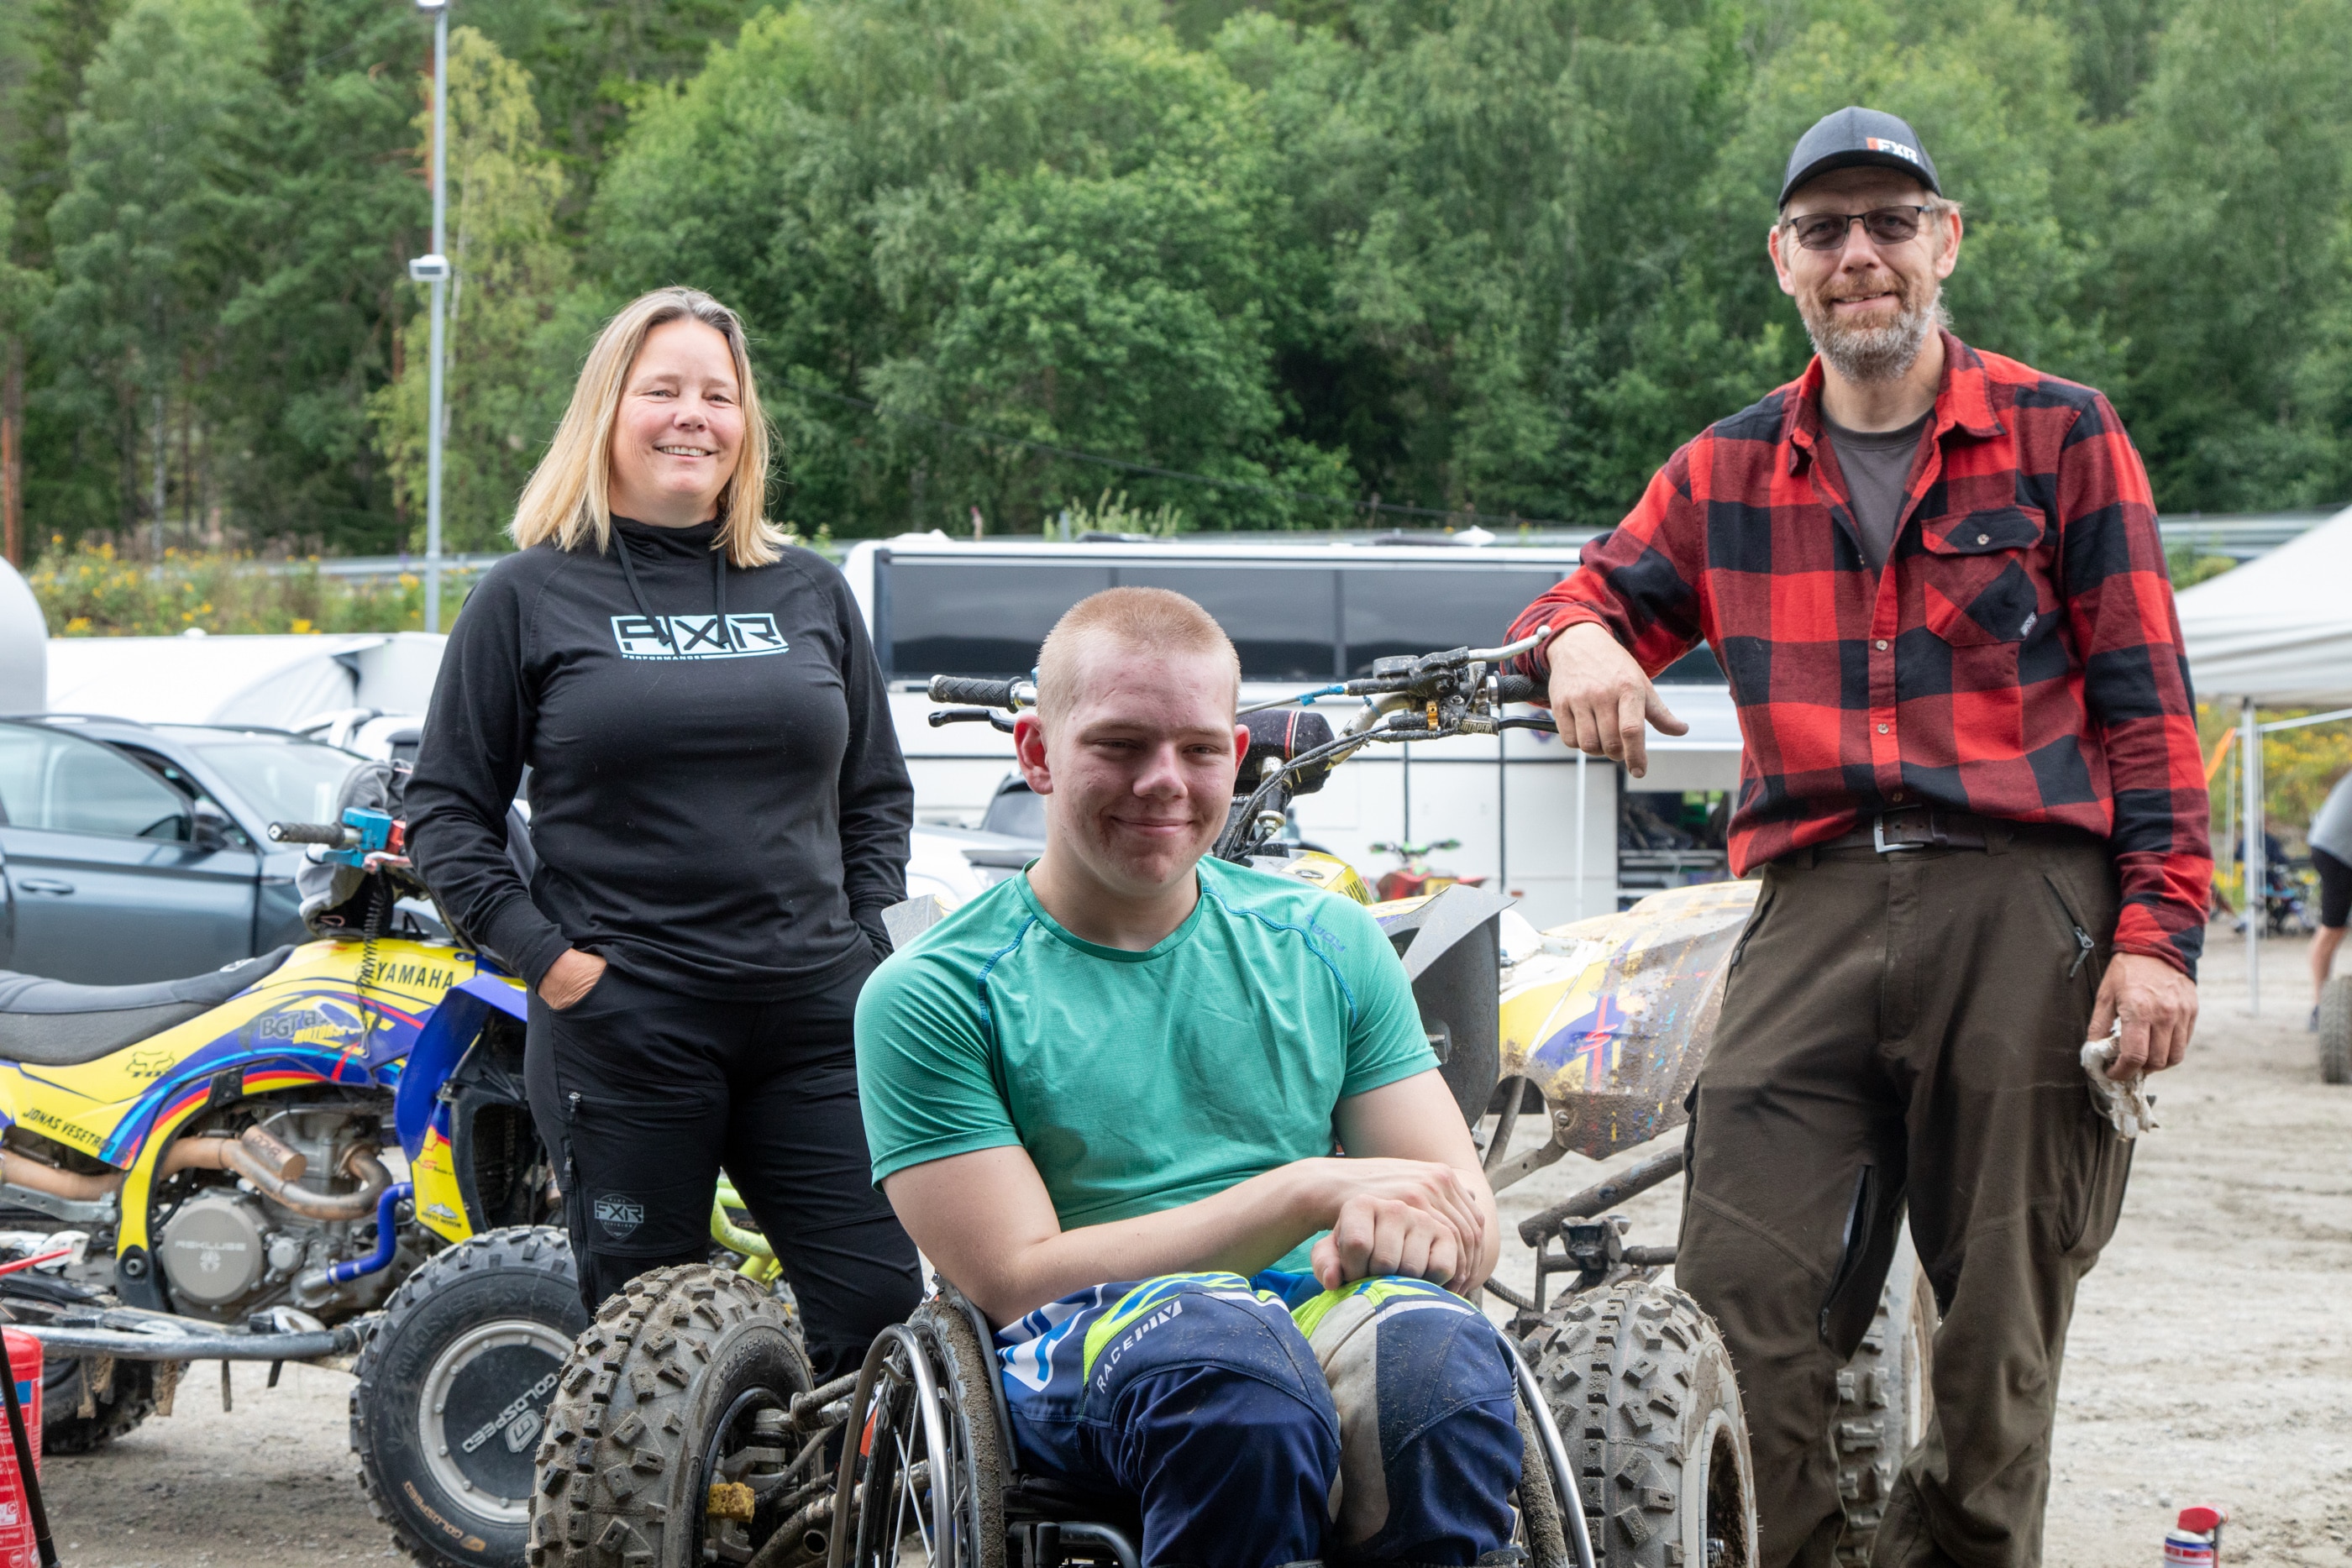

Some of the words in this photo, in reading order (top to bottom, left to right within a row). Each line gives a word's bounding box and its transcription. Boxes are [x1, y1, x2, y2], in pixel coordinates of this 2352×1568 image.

[1877, 138, 1919, 165] FXR
[613, 615, 786, 653] FXR
[376, 962, 454, 990] YAMAHA
[260, 1010, 302, 1040] BGT
[22, 1108, 63, 1130] JONAS
[595, 1201, 643, 1223] FXR
[1096, 1335, 1134, 1394] RACE
[461, 1371, 558, 1454] GOLDSPEED
[403, 1480, 464, 1539] GOLDSPEED
